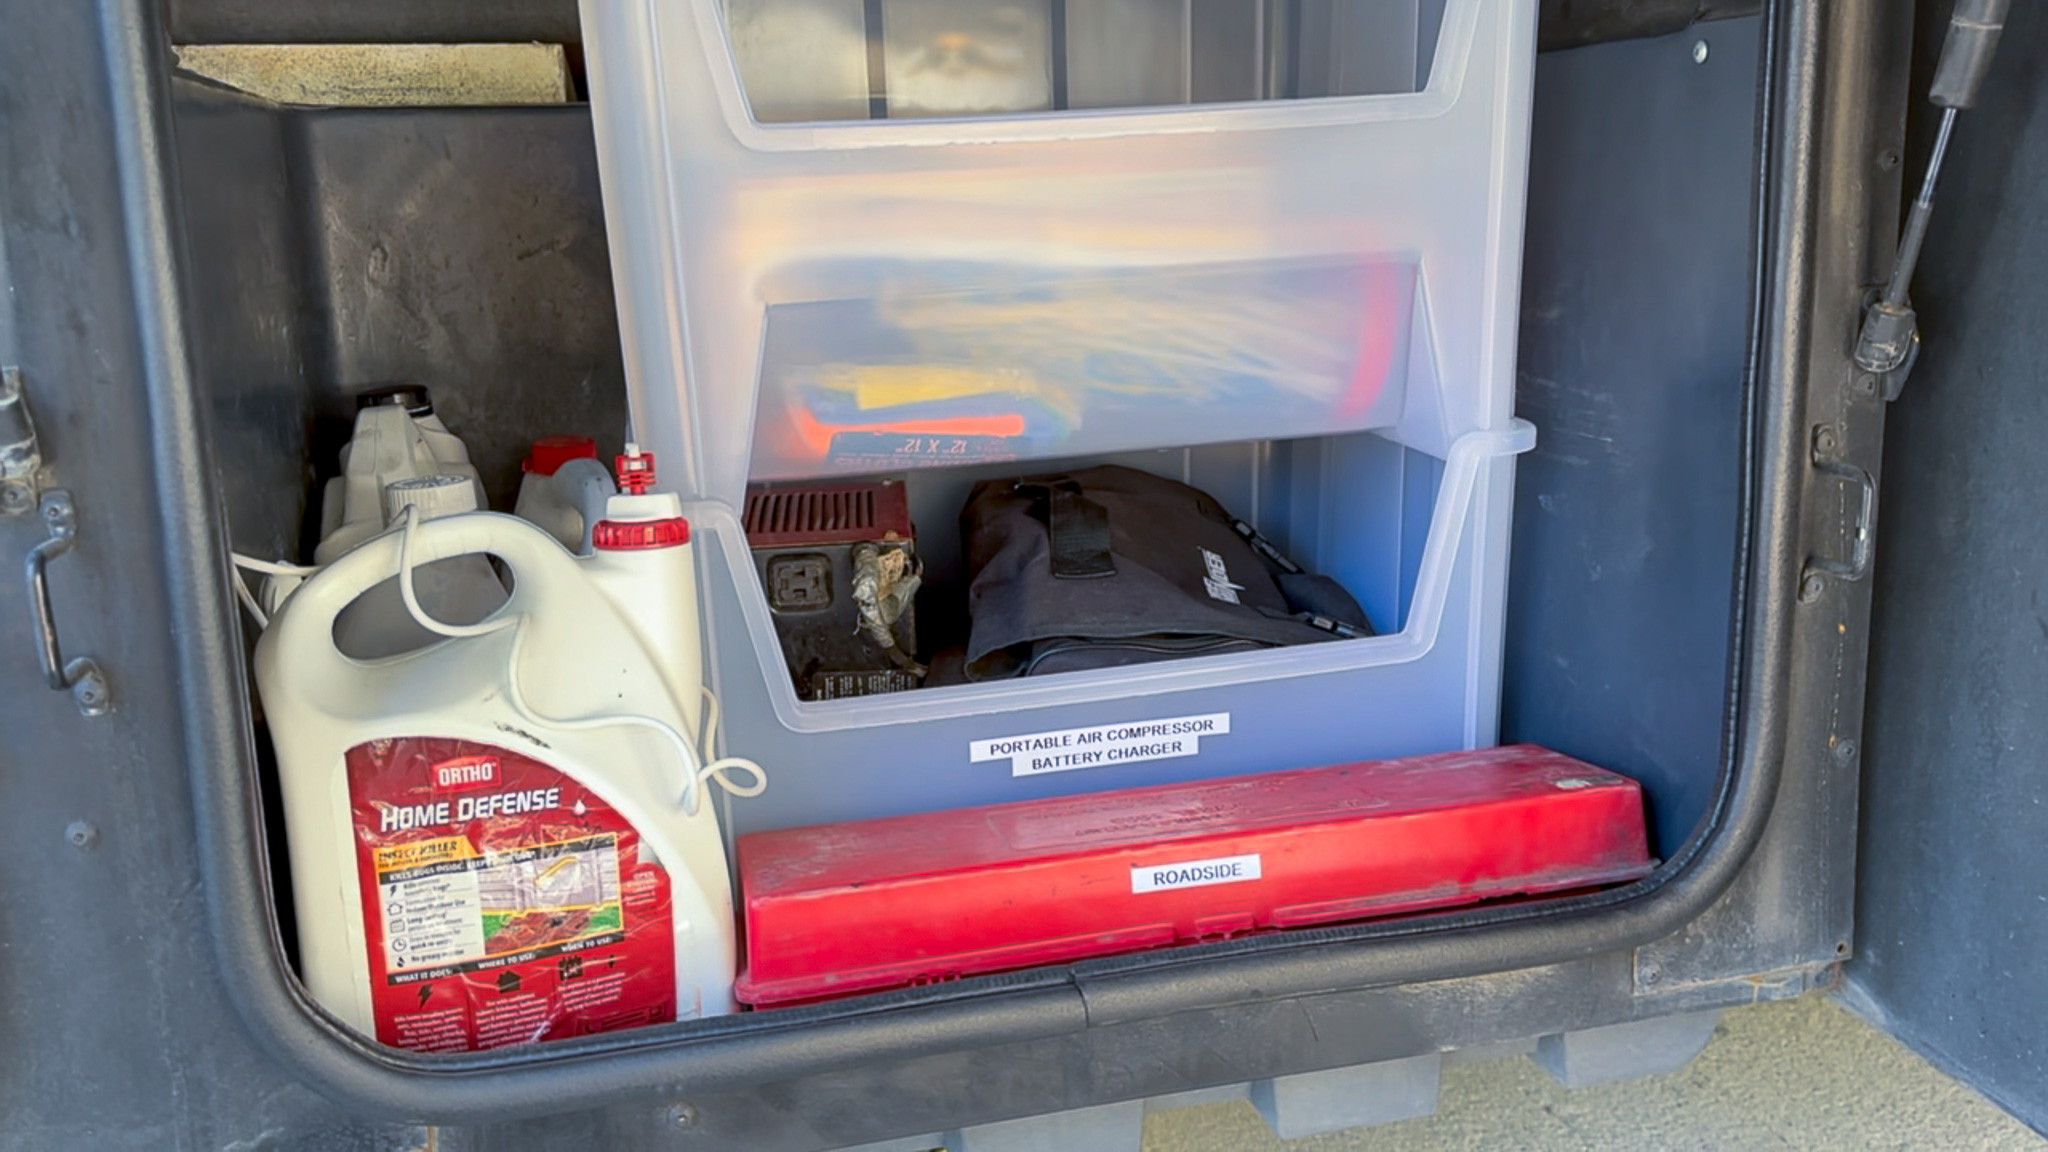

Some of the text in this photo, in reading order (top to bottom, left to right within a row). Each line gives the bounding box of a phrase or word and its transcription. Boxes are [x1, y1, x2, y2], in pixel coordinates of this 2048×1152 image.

[990, 719, 1214, 755] PORTABLE AIR COMPRESSOR
[1032, 741, 1182, 770] BATTERY CHARGER
[438, 763, 492, 787] ORTHO
[381, 787, 560, 832] HOME DEFENSE
[1153, 862, 1243, 886] ROADSIDE
